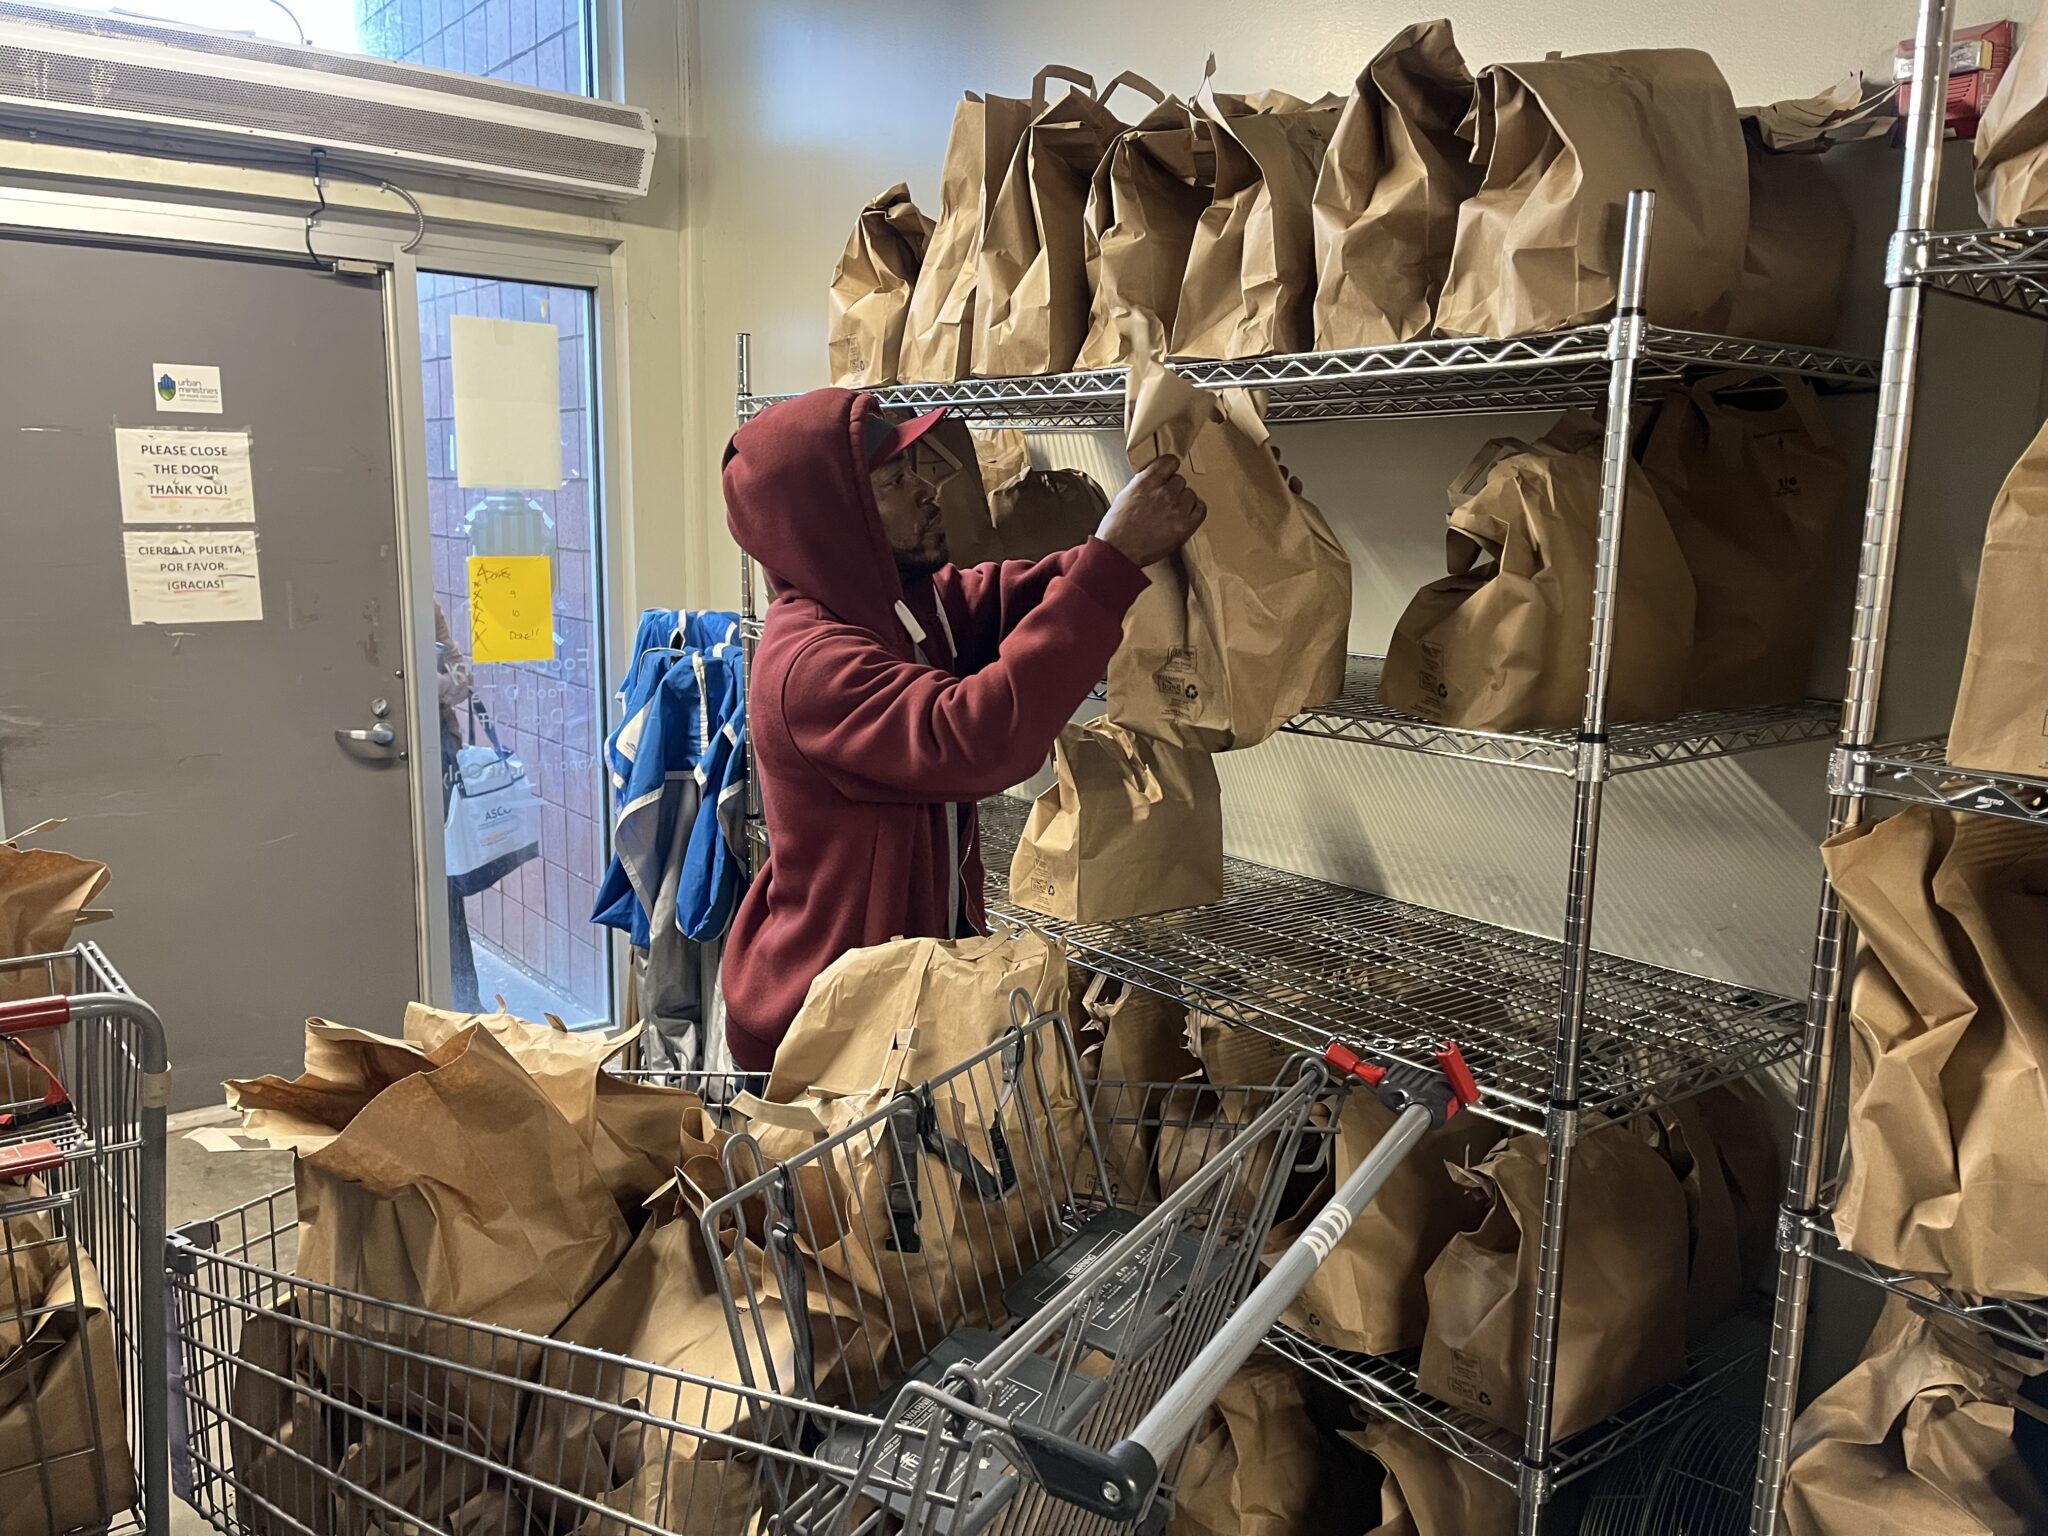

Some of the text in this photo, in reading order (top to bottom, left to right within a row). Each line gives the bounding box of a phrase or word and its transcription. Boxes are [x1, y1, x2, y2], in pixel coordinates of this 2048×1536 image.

[178, 377, 201, 388] urban
[178, 387, 219, 395] ministries
[141, 445, 228, 456] PLEASE CLOSE
[153, 464, 219, 475] THE DOOR
[148, 484, 228, 495] THANK YOU!
[138, 545, 245, 556] CIERRA LA PUERTA,
[160, 563, 184, 572] POR
[167, 580, 224, 591] ¡GRACIAS!
[1301, 1203, 1352, 1267] ALDI
[904, 1397, 931, 1420] WARNI
